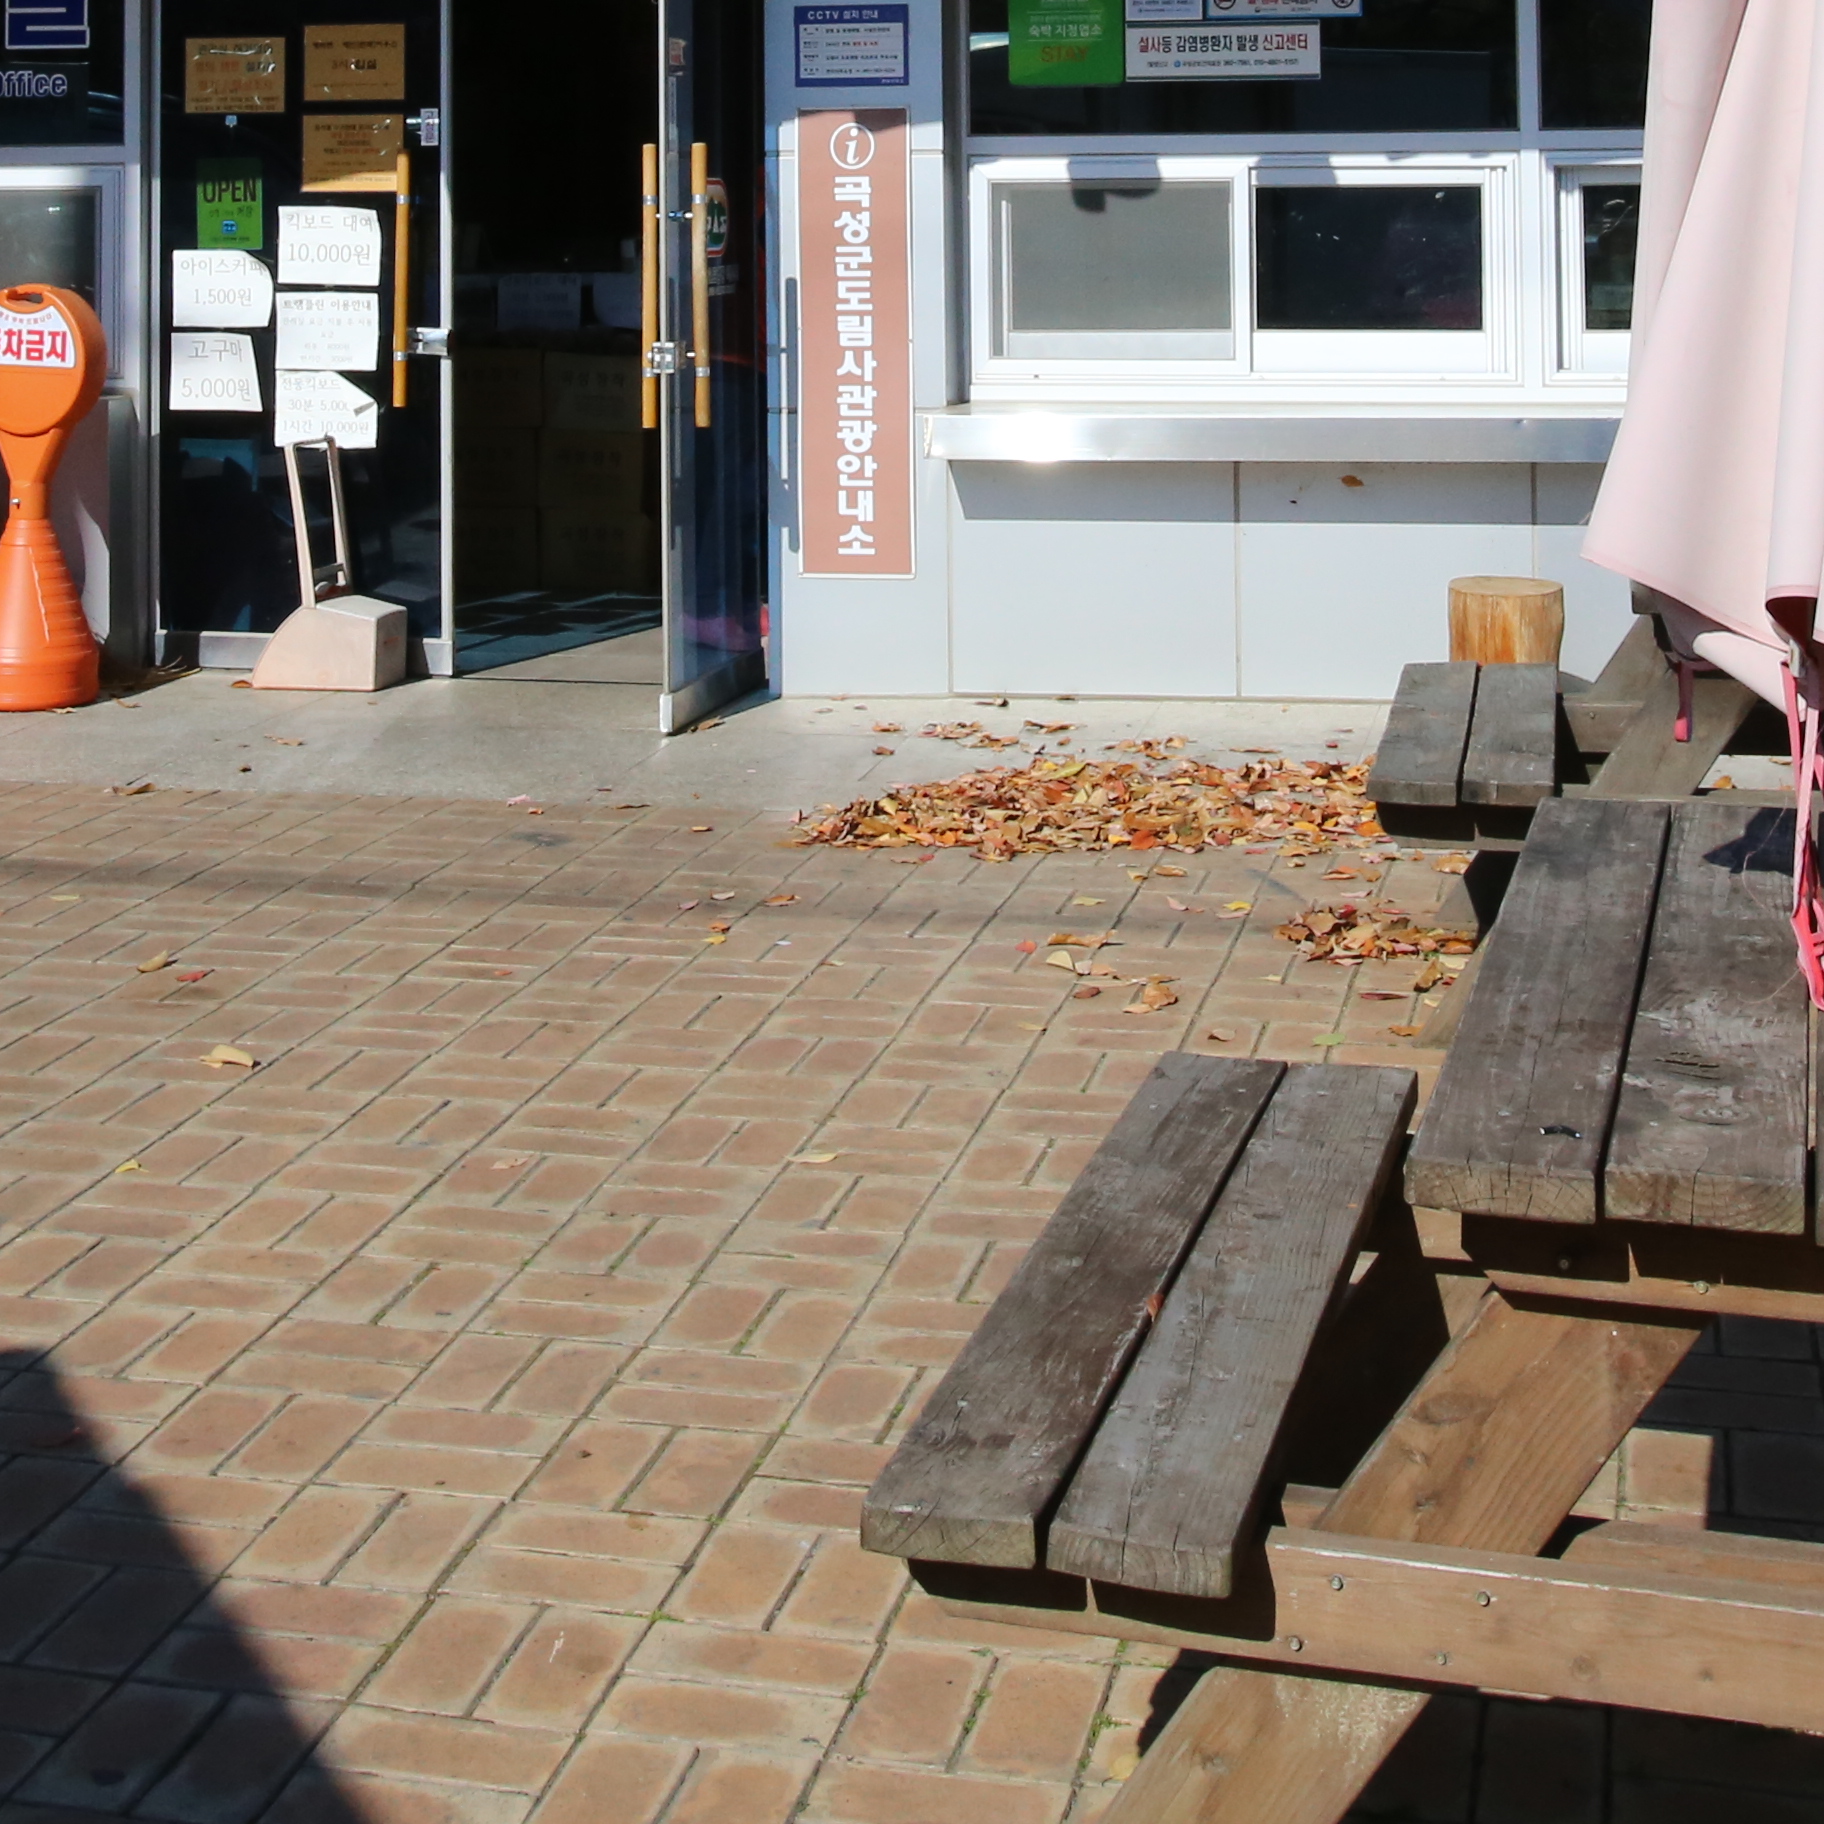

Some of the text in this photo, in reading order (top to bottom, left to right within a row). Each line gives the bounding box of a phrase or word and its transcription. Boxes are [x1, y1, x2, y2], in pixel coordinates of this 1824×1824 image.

[807, 9, 879, 20] CCTV 설치 안내
[1138, 33, 1308, 53] 설사등 감염병환자 발생 신고센터
[1041, 45, 1090, 63] STAY
[202, 177, 257, 203] OPEN
[285, 212, 334, 232] 킥보드
[330, 299, 372, 312] 이용안내
[188, 339, 243, 363] 고구마
[833, 175, 877, 556] 곡성군도림사관광안내소
[287, 398, 315, 413] 30분
[283, 419, 313, 434] 1시간
